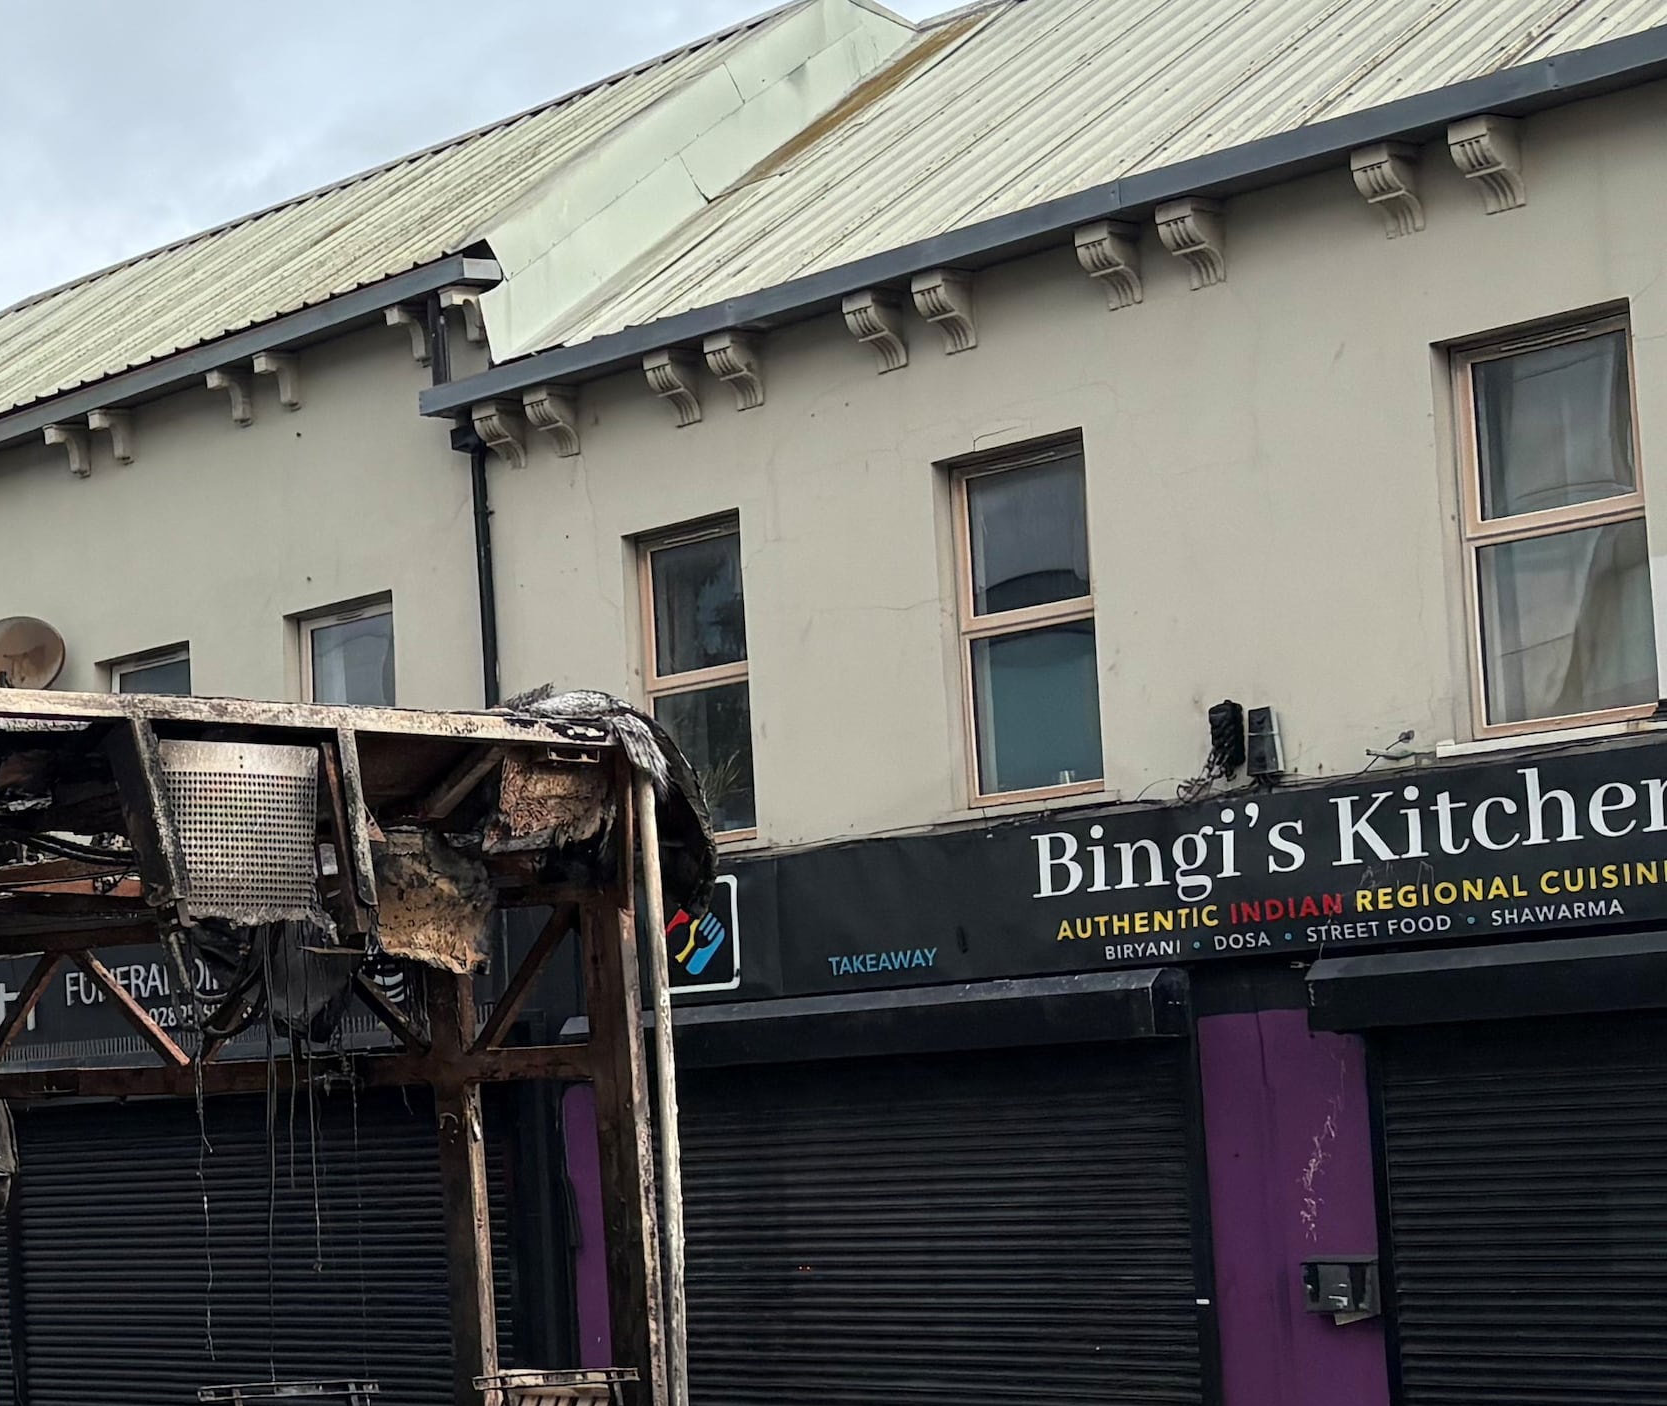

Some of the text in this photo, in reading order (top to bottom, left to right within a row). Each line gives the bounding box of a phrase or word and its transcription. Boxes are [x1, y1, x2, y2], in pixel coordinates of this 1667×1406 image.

[1030, 802, 1307, 903] Bingi's
[1056, 859, 1667, 942] AUTHENTIC INDIAN REGIONAL CUISIN
[1104, 898, 1625, 961] BIRYANI DOSA STREET FOOD SHAWARMA
[827, 946, 938, 977] TAKEAWAY
